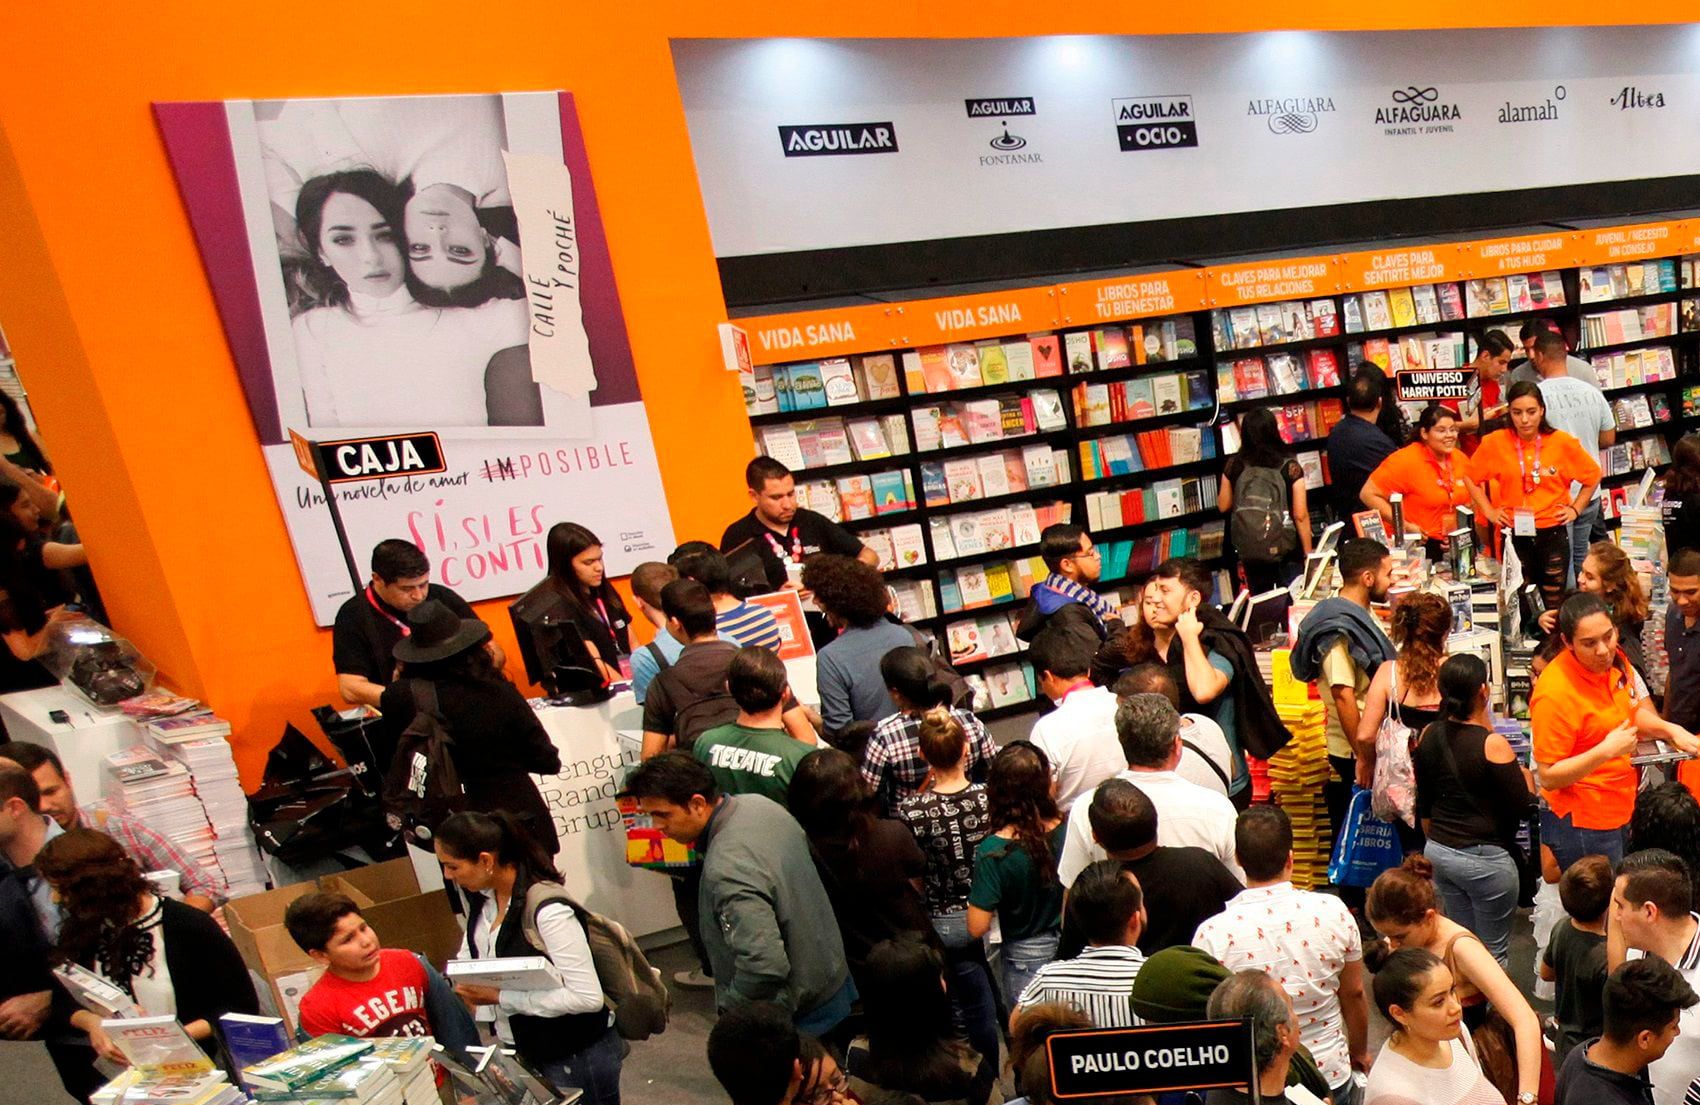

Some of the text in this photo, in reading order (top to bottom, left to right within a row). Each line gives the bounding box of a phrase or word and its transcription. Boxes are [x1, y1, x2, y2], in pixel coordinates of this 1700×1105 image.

[970, 100, 1033, 116] AGUILAR
[1247, 97, 1336, 116] ALFAGUARA
[1610, 87, 1666, 111] Altea
[1118, 102, 1191, 120] AGUILAR
[1375, 104, 1461, 124] ALFAGUARA
[786, 127, 893, 153] AGUILAR
[1135, 127, 1178, 146] OCIO
[1384, 125, 1454, 136] INFANTIL JUVENIL
[979, 154, 1042, 166] FONTANAR
[548, 208, 577, 273] POCHÉ
[1372, 251, 1435, 271] CLAVES PARA
[554, 274, 575, 290] Y
[1221, 263, 1327, 287] CLAVES PARA MEJORAR
[1363, 264, 1445, 286] SENTIRTE MEJOR
[1097, 280, 1169, 302] LIBROS PARA
[1237, 279, 1314, 298] TUS RELACIONES
[532, 272, 555, 338] CALLE
[1096, 296, 1175, 318] TU BIENESTAR
[936, 303, 1022, 331] VIDA SANA
[759, 328, 803, 351] VIDA
[807, 321, 856, 346] SANA
[1411, 372, 1463, 385] UNIVERSO
[1401, 385, 1432, 398] HARRY
[337, 439, 425, 477] CAJA
[343, 478, 400, 502] novela
[403, 476, 425, 493] de
[429, 471, 471, 488] amor
[508, 503, 545, 538] ES
[709, 743, 782, 778] TECATE
[1070, 1044, 1230, 1075] PAULO COELHO
